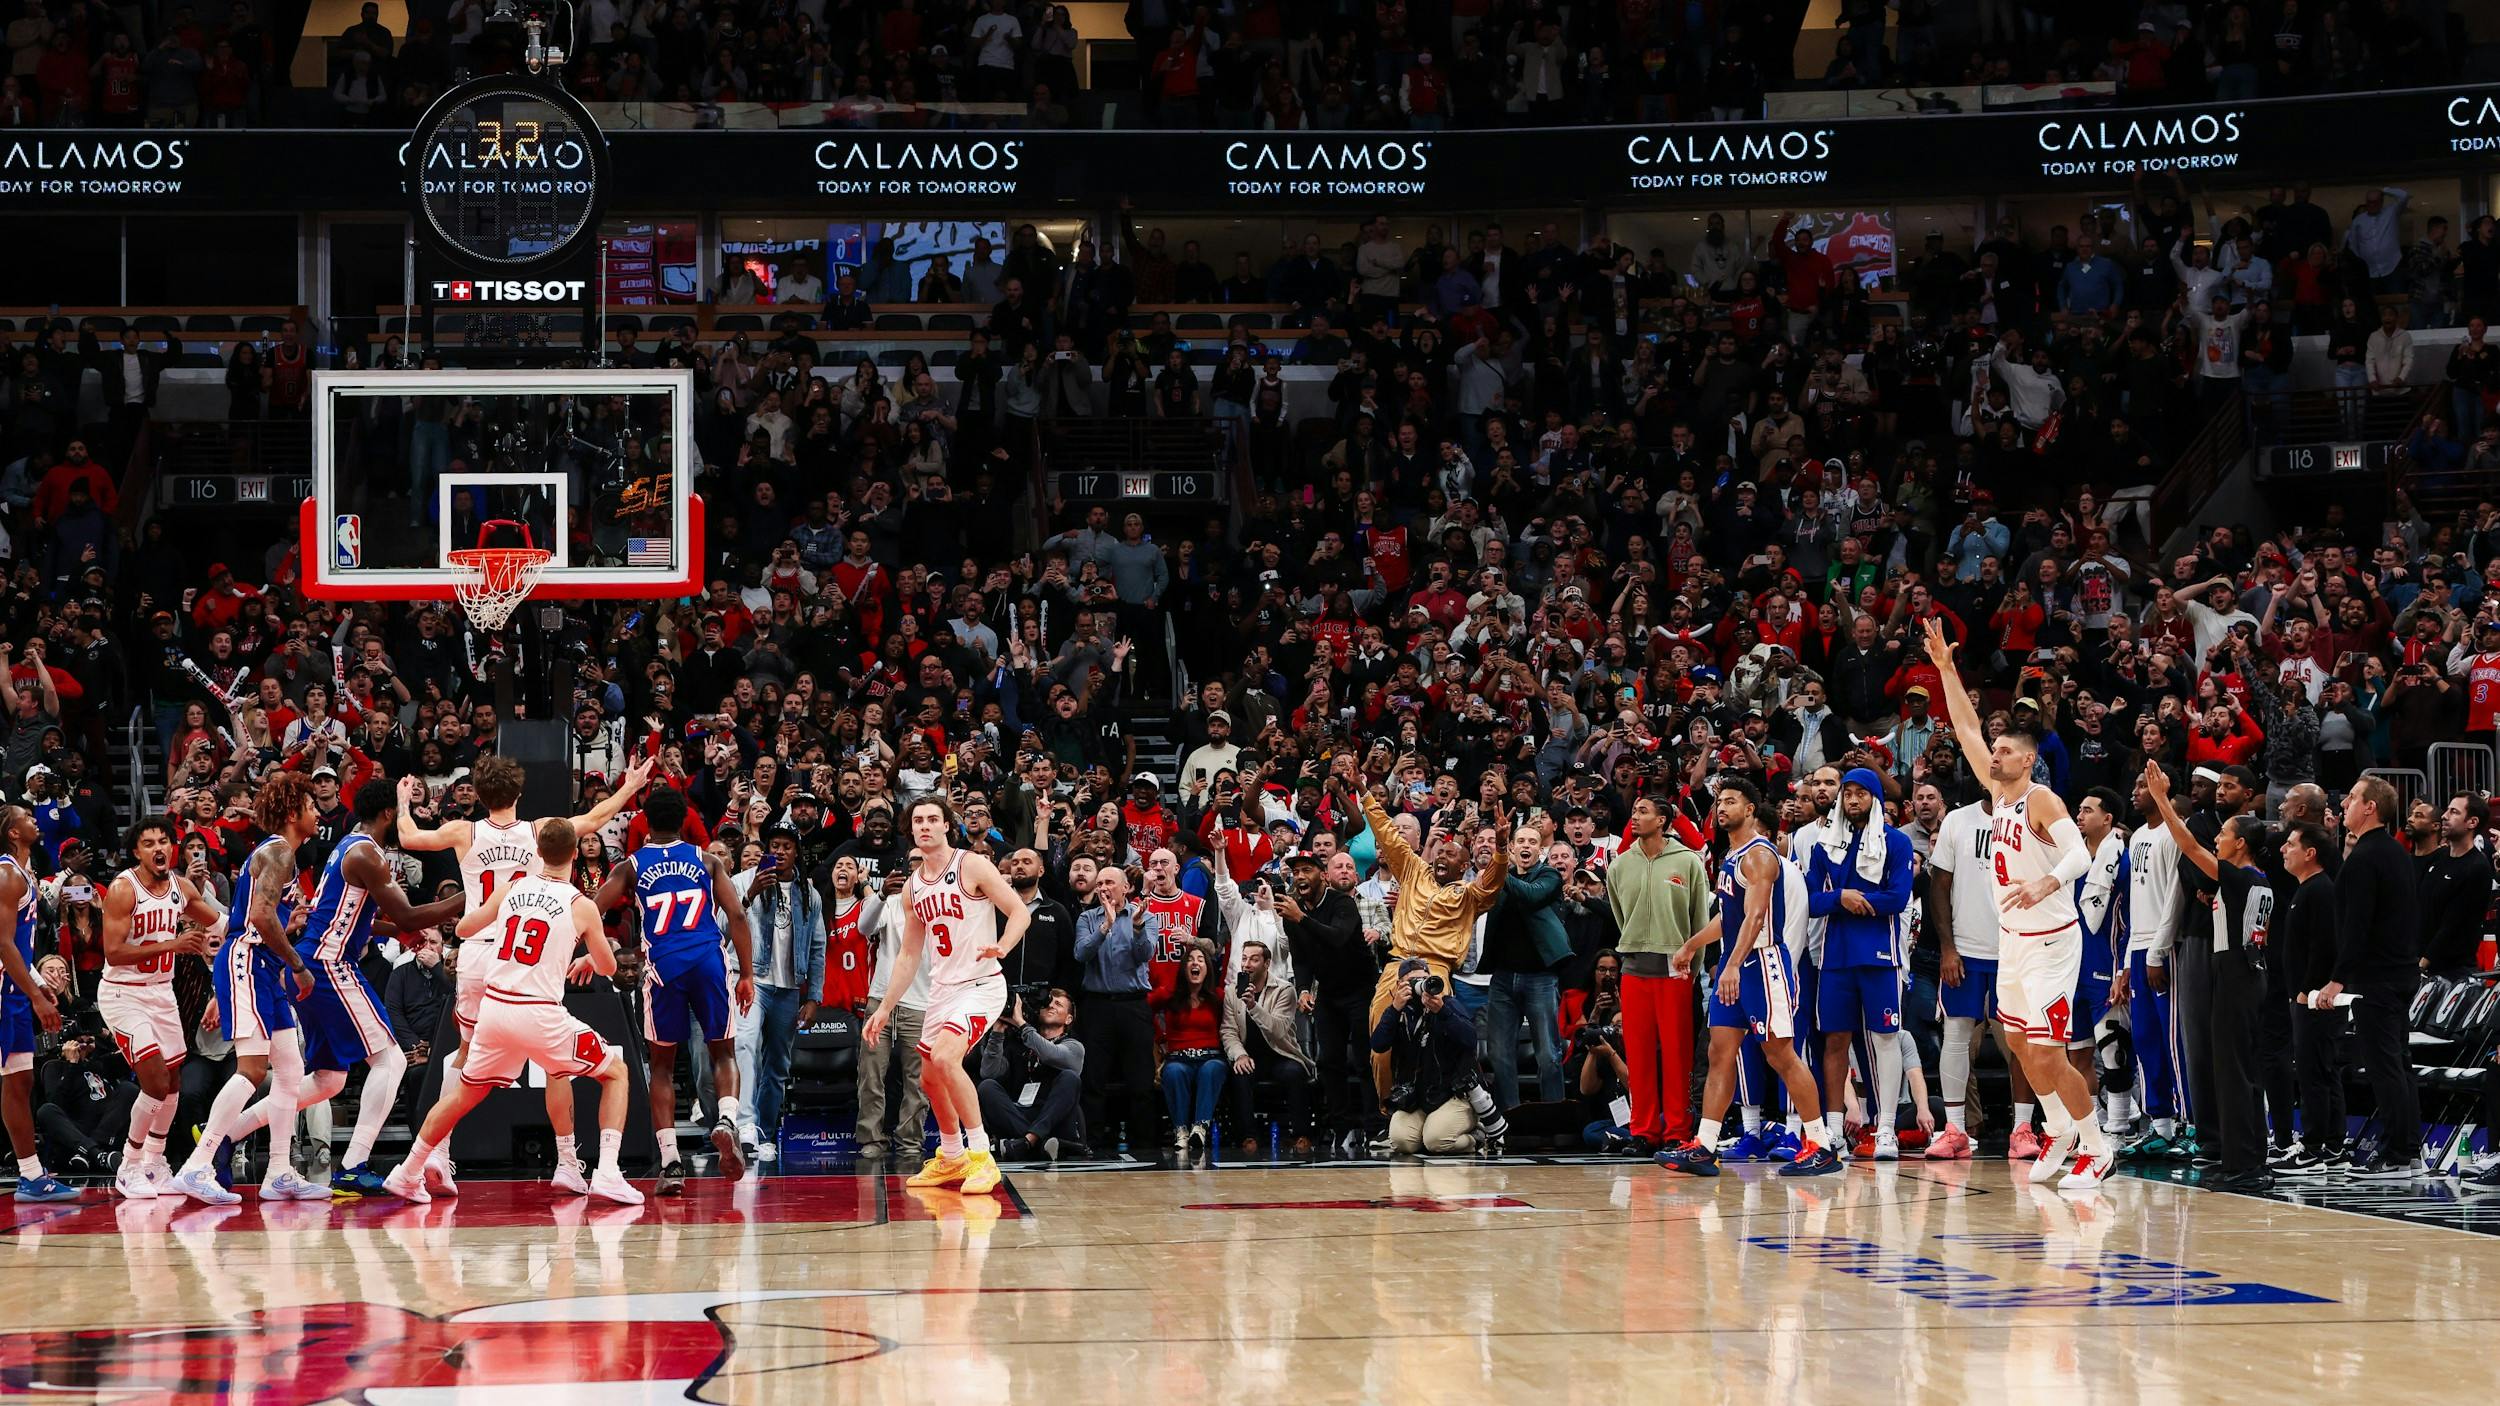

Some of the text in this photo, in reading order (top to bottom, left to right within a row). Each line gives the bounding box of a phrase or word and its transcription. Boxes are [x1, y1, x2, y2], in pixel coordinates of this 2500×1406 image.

[477, 121, 539, 161] 3.2
[2039, 114, 2240, 152] CALAMOS
[3, 140, 186, 170] ALAMOS
[815, 140, 1020, 170] CALAMOS
[1226, 141, 1428, 171] CALAMOS
[1627, 130, 1831, 165] CALAMOS
[1631, 170, 1828, 188] TODAY FOR TOMORROW
[2042, 161, 2096, 176] TODAY
[2104, 158, 2136, 174] FOR
[0, 180, 182, 194] DAY FOR TOMORROW
[817, 181, 1017, 194] TODAY FOR TOMORROW
[1229, 181, 1426, 194] TODAY FOR TOMORROW
[474, 280, 586, 301] TISSOT
[2288, 448, 2360, 470] 118 EXIT
[189, 479, 217, 499] 116
[240, 480, 265, 499] EXIT
[1077, 475, 1198, 495] 117 EXIT 118
[476, 846, 534, 867] BUZELIS
[2130, 842, 2153, 875] VOTE
[637, 860, 706, 891] EDGECOMBE
[1994, 851, 2011, 887] 9
[507, 893, 565, 919] HUERTER
[646, 888, 707, 936] 77
[914, 893, 965, 926] BULLS
[829, 921, 857, 941] cago
[1156, 911, 1193, 934] ULLS
[497, 914, 551, 967] 13
[931, 923, 953, 958] 3
[842, 951, 857, 971] 0
[820, 1021, 848, 1030] RABIDA
